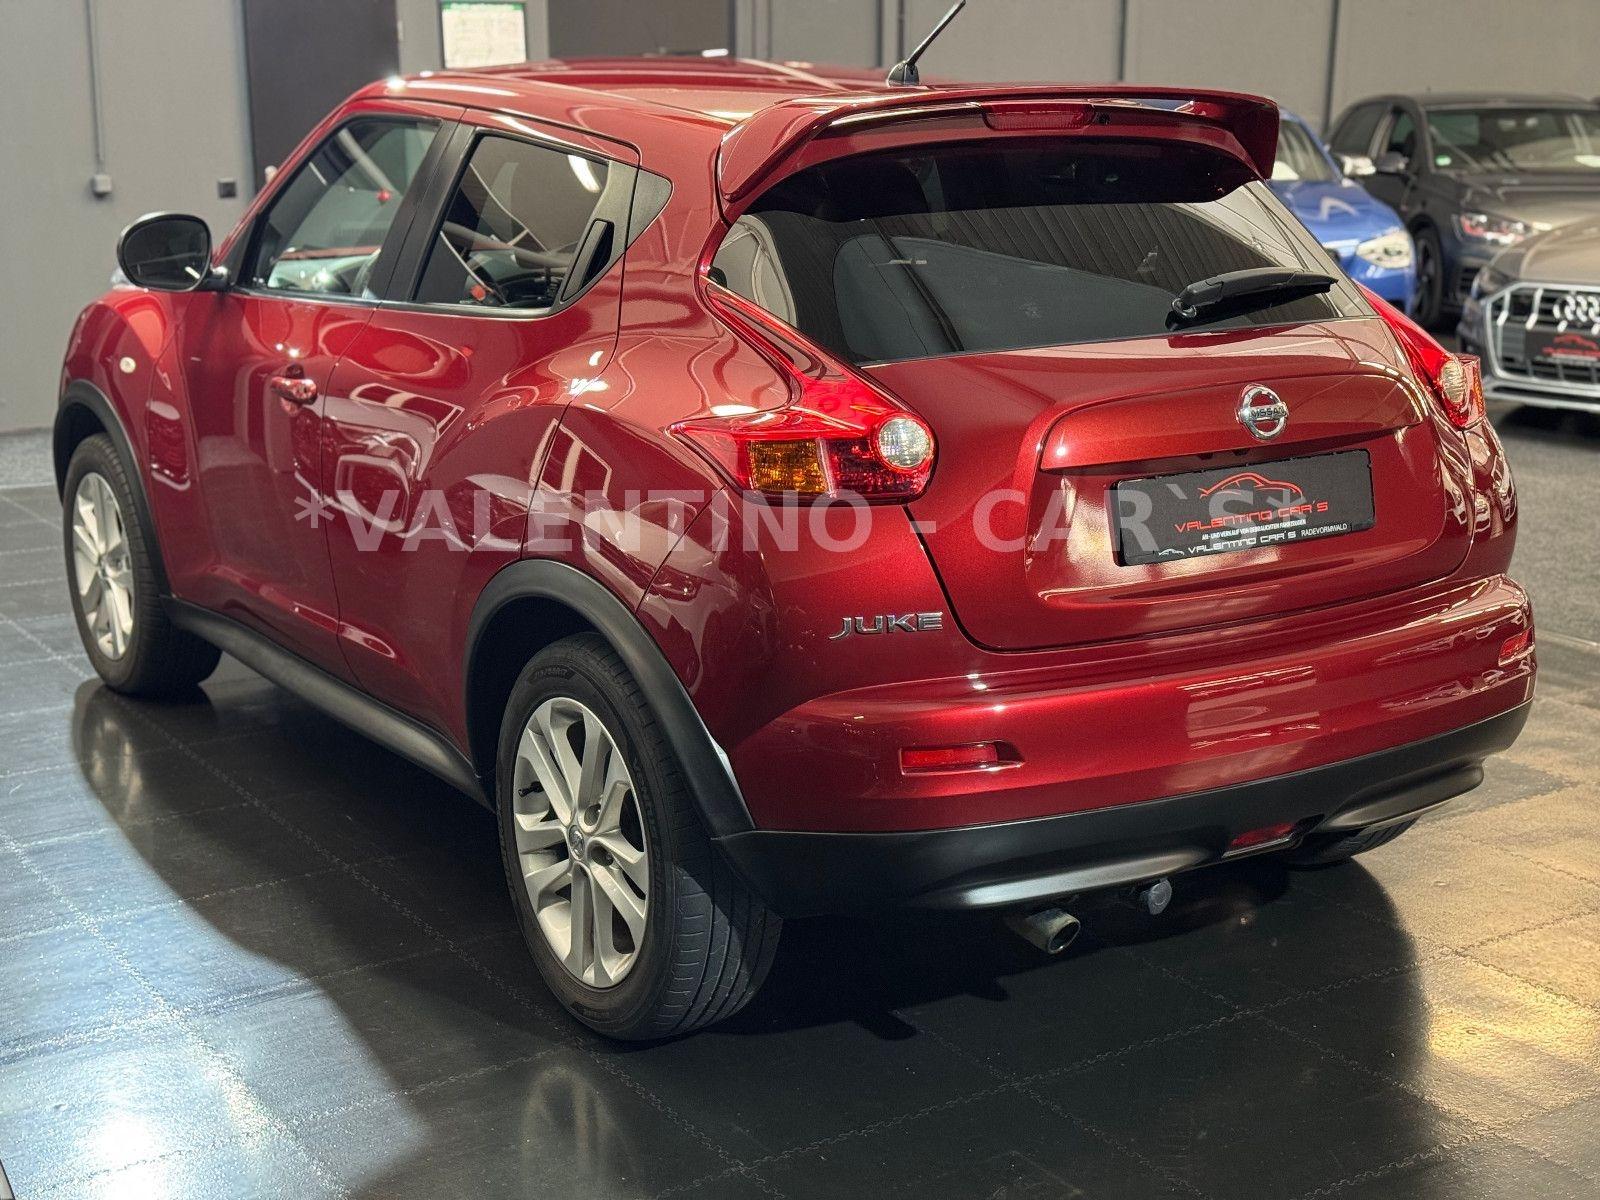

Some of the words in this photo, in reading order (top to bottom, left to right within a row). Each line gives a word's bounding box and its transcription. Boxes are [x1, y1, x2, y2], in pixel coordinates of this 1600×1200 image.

[1250, 405, 1287, 418] NISSAN
[1175, 510, 1273, 534] VALENTINO
[1188, 537, 1257, 554] VALENTINO
[828, 612, 944, 641] JUKE
